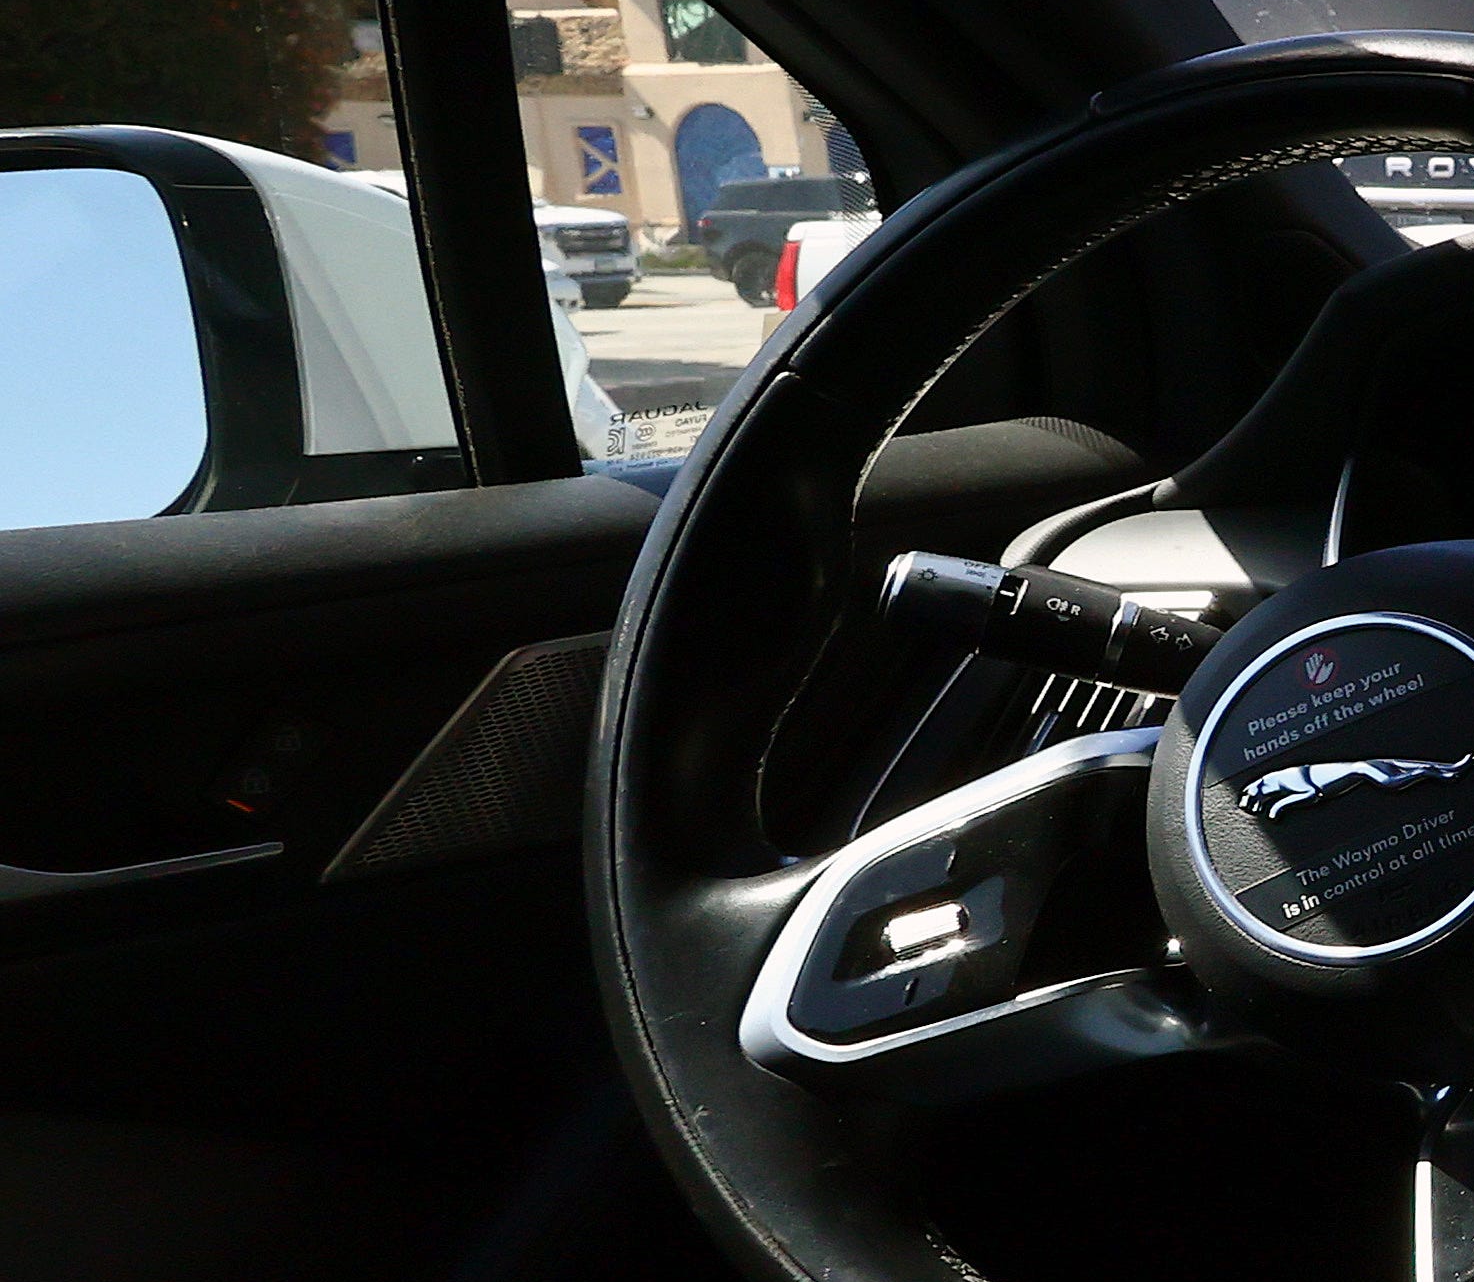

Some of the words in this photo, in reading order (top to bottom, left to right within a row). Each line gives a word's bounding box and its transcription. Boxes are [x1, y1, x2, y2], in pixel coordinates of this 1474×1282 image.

[1243, 728, 1299, 761] hands
[1304, 714, 1330, 735] off
[1334, 701, 1364, 722] the
[1369, 674, 1425, 708] wheel
[1248, 702, 1308, 737] Please
[1311, 682, 1355, 711] keep
[1359, 662, 1402, 692] your
[1282, 902, 1301, 920] is
[1300, 894, 1321, 910] in
[1324, 863, 1384, 900] control
[1389, 855, 1408, 872] at
[1412, 842, 1435, 861] all
[1297, 864, 1330, 887] The
[1333, 835, 1399, 871] Waymo
[1402, 810, 1456, 841] Driver
